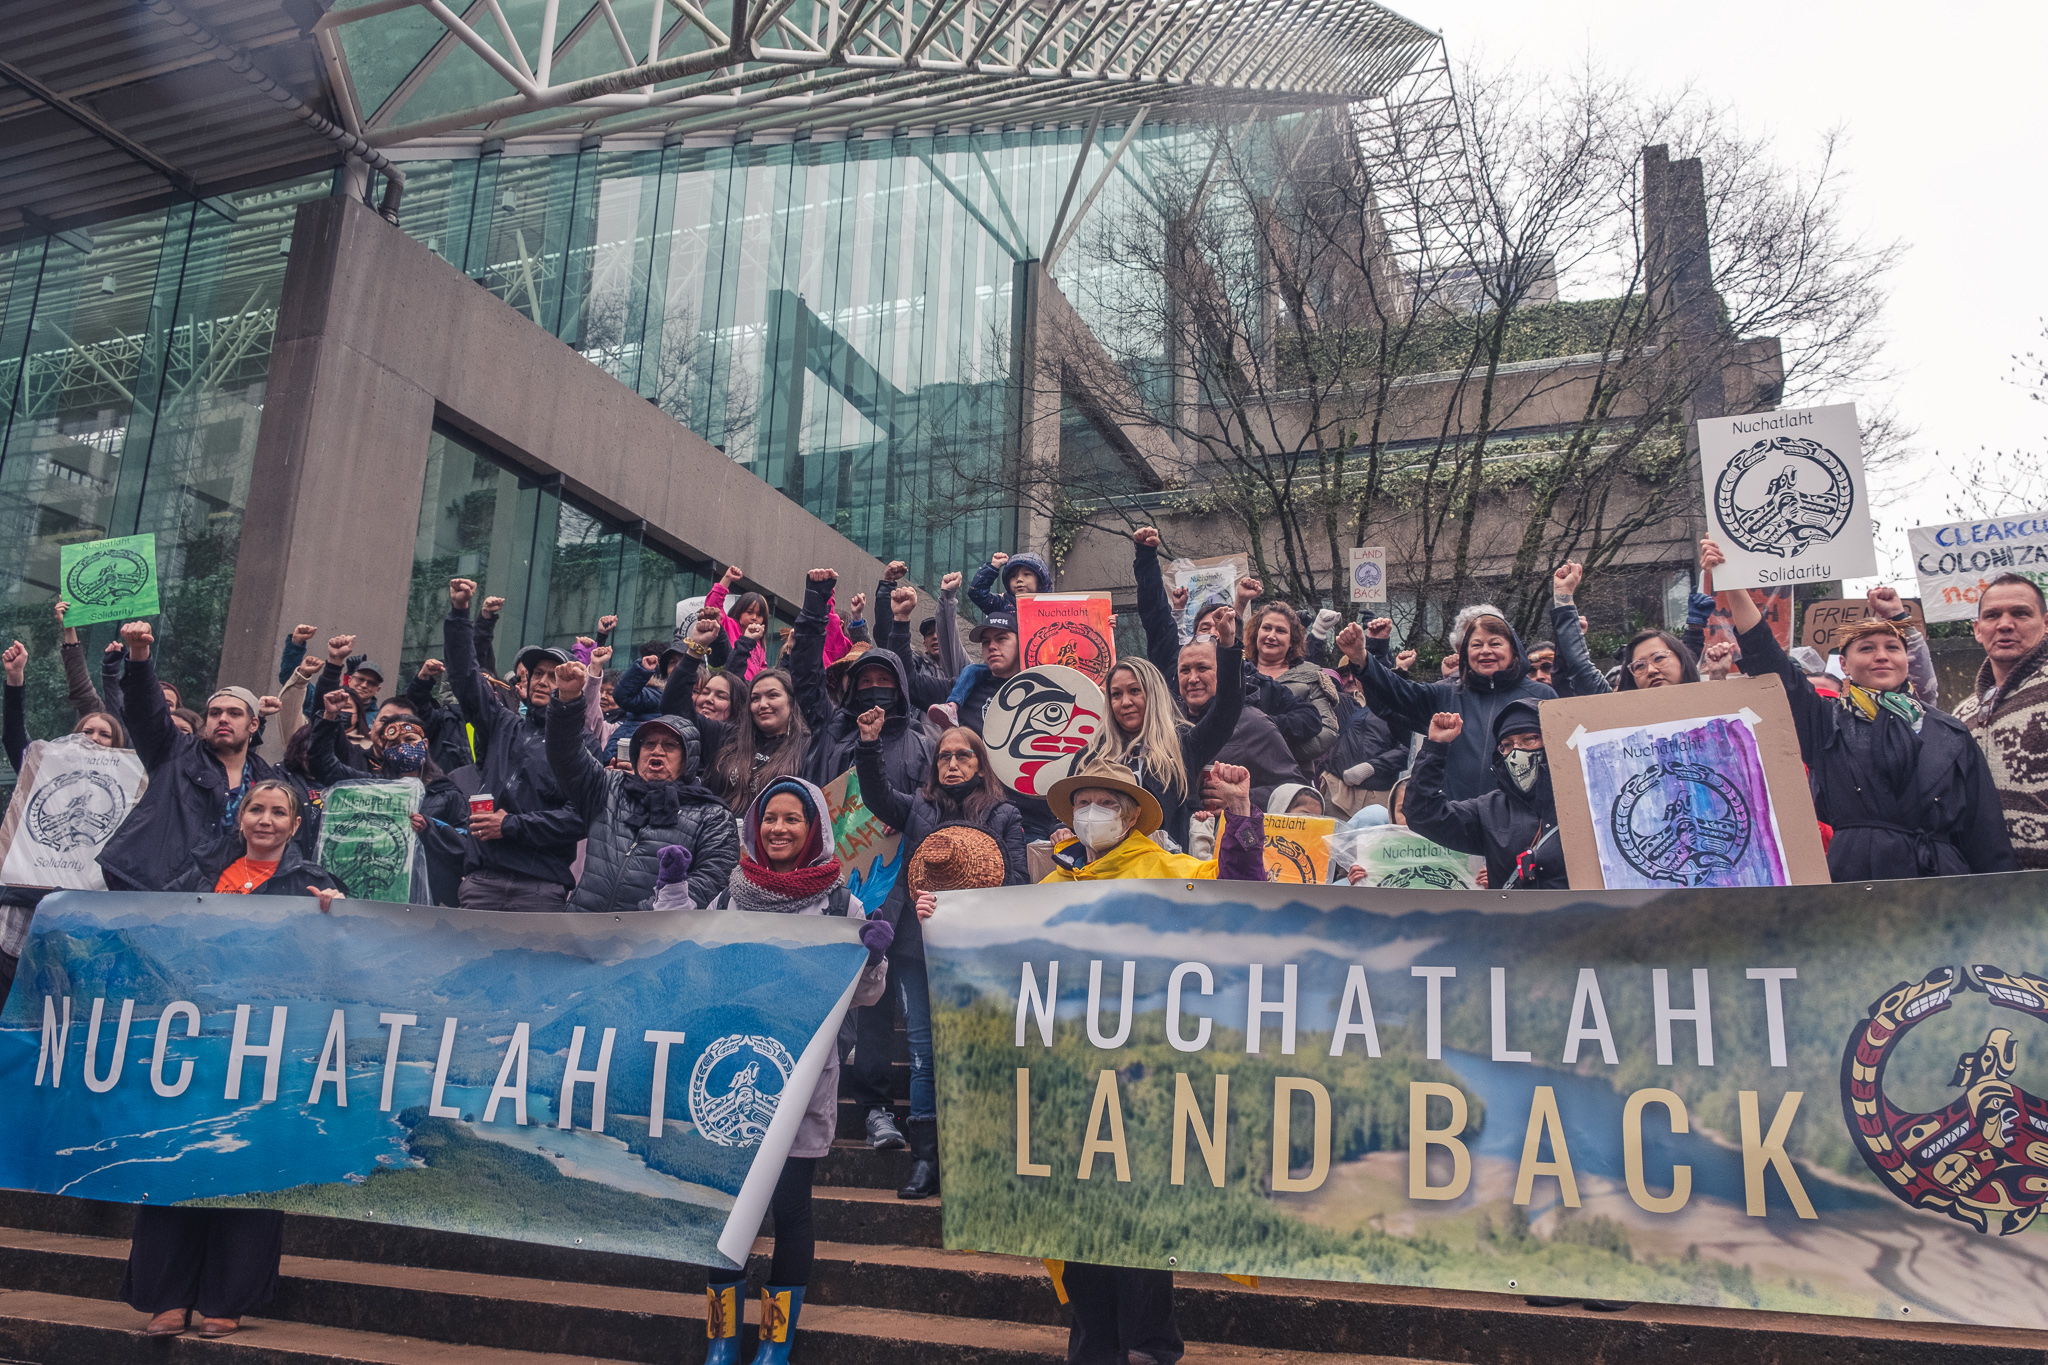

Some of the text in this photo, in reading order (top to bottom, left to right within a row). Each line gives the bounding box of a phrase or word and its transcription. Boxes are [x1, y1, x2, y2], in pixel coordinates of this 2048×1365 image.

[1732, 411, 1815, 434] Nuchatlaht
[1935, 519, 2048, 547] CLEARCU
[81, 537, 131, 551] Nuchatlaht
[1354, 549, 1383, 560] LAND
[1918, 544, 2048, 576] COLONIZA
[1190, 571, 1223, 583] Nucha
[1758, 563, 1831, 583] Solidarity
[1353, 588, 1381, 599] BACK
[89, 607, 134, 621] Solidarity
[1037, 607, 1089, 618] Nuchatlaht
[1813, 604, 1912, 624] FRIEN
[1813, 627, 1838, 645] OF
[1622, 736, 1704, 760] Nuchatlaht
[1264, 816, 1307, 831] chatlaht
[34, 856, 86, 872] Solidarity
[1015, 960, 1798, 1068] NUCHATLAHT
[34, 995, 686, 1139] NUCHATLAHT
[1015, 1067, 1819, 1220] LAND BACK
